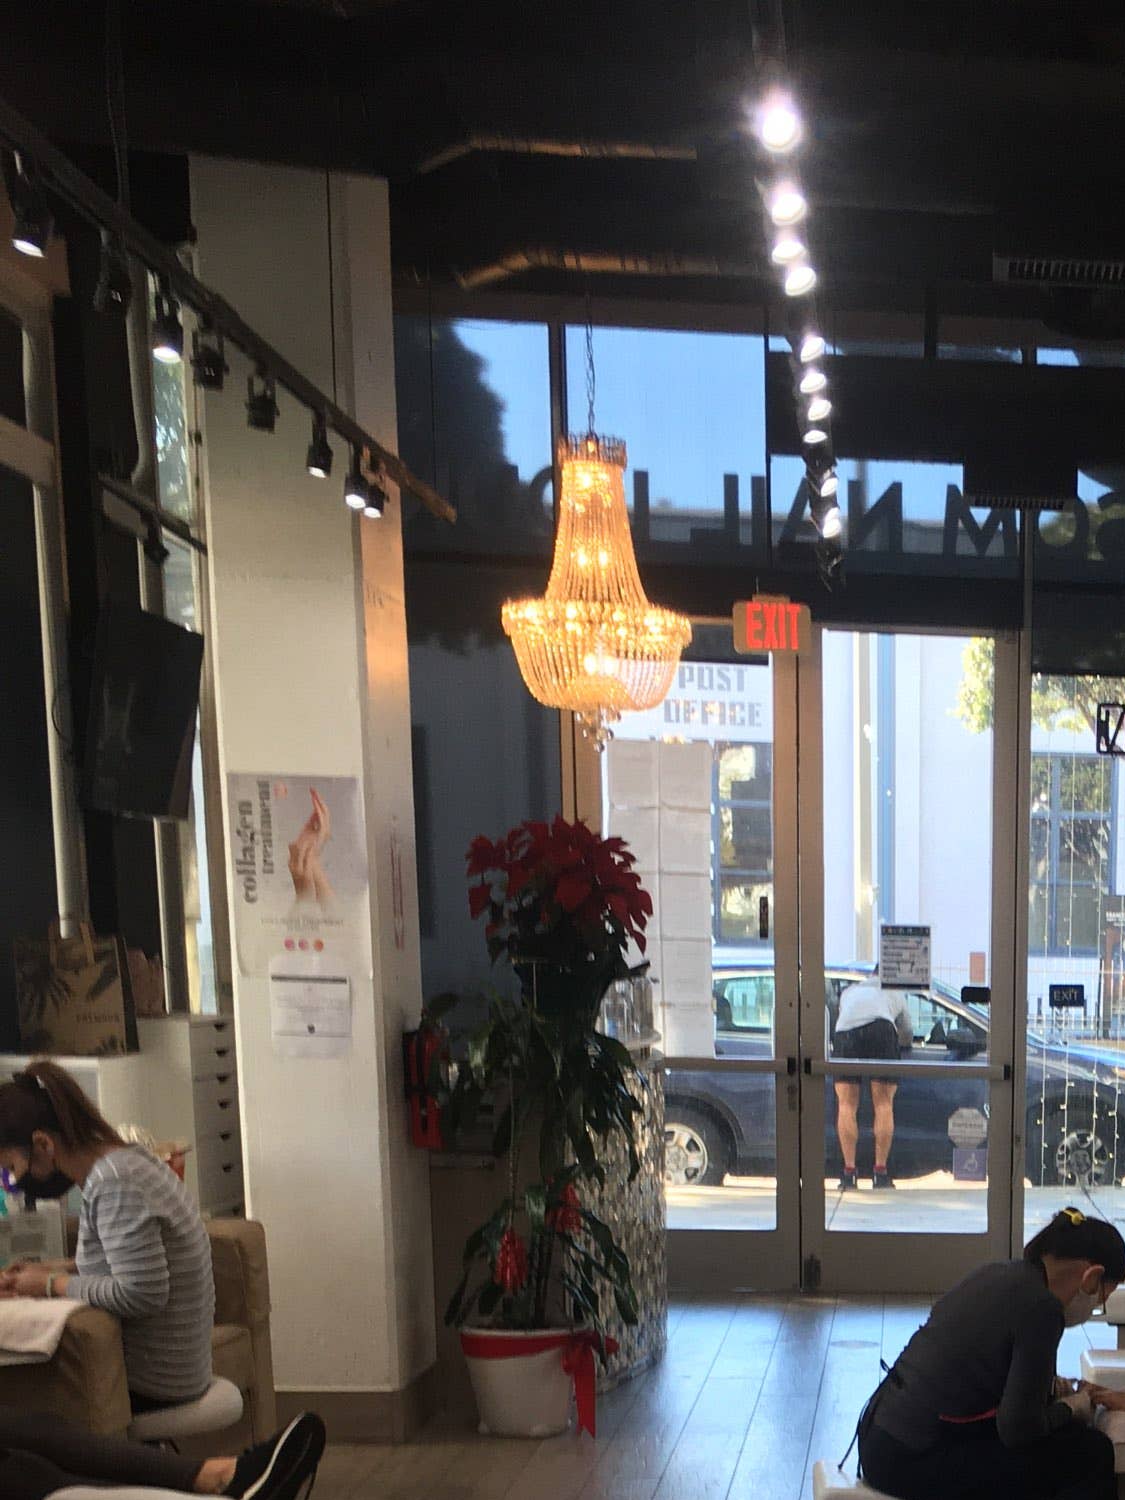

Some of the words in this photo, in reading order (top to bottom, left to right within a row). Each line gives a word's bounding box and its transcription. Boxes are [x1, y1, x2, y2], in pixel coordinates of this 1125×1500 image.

[746, 602, 801, 651] EXIT
[678, 665, 748, 692] POST
[664, 699, 762, 727] OFFICE
